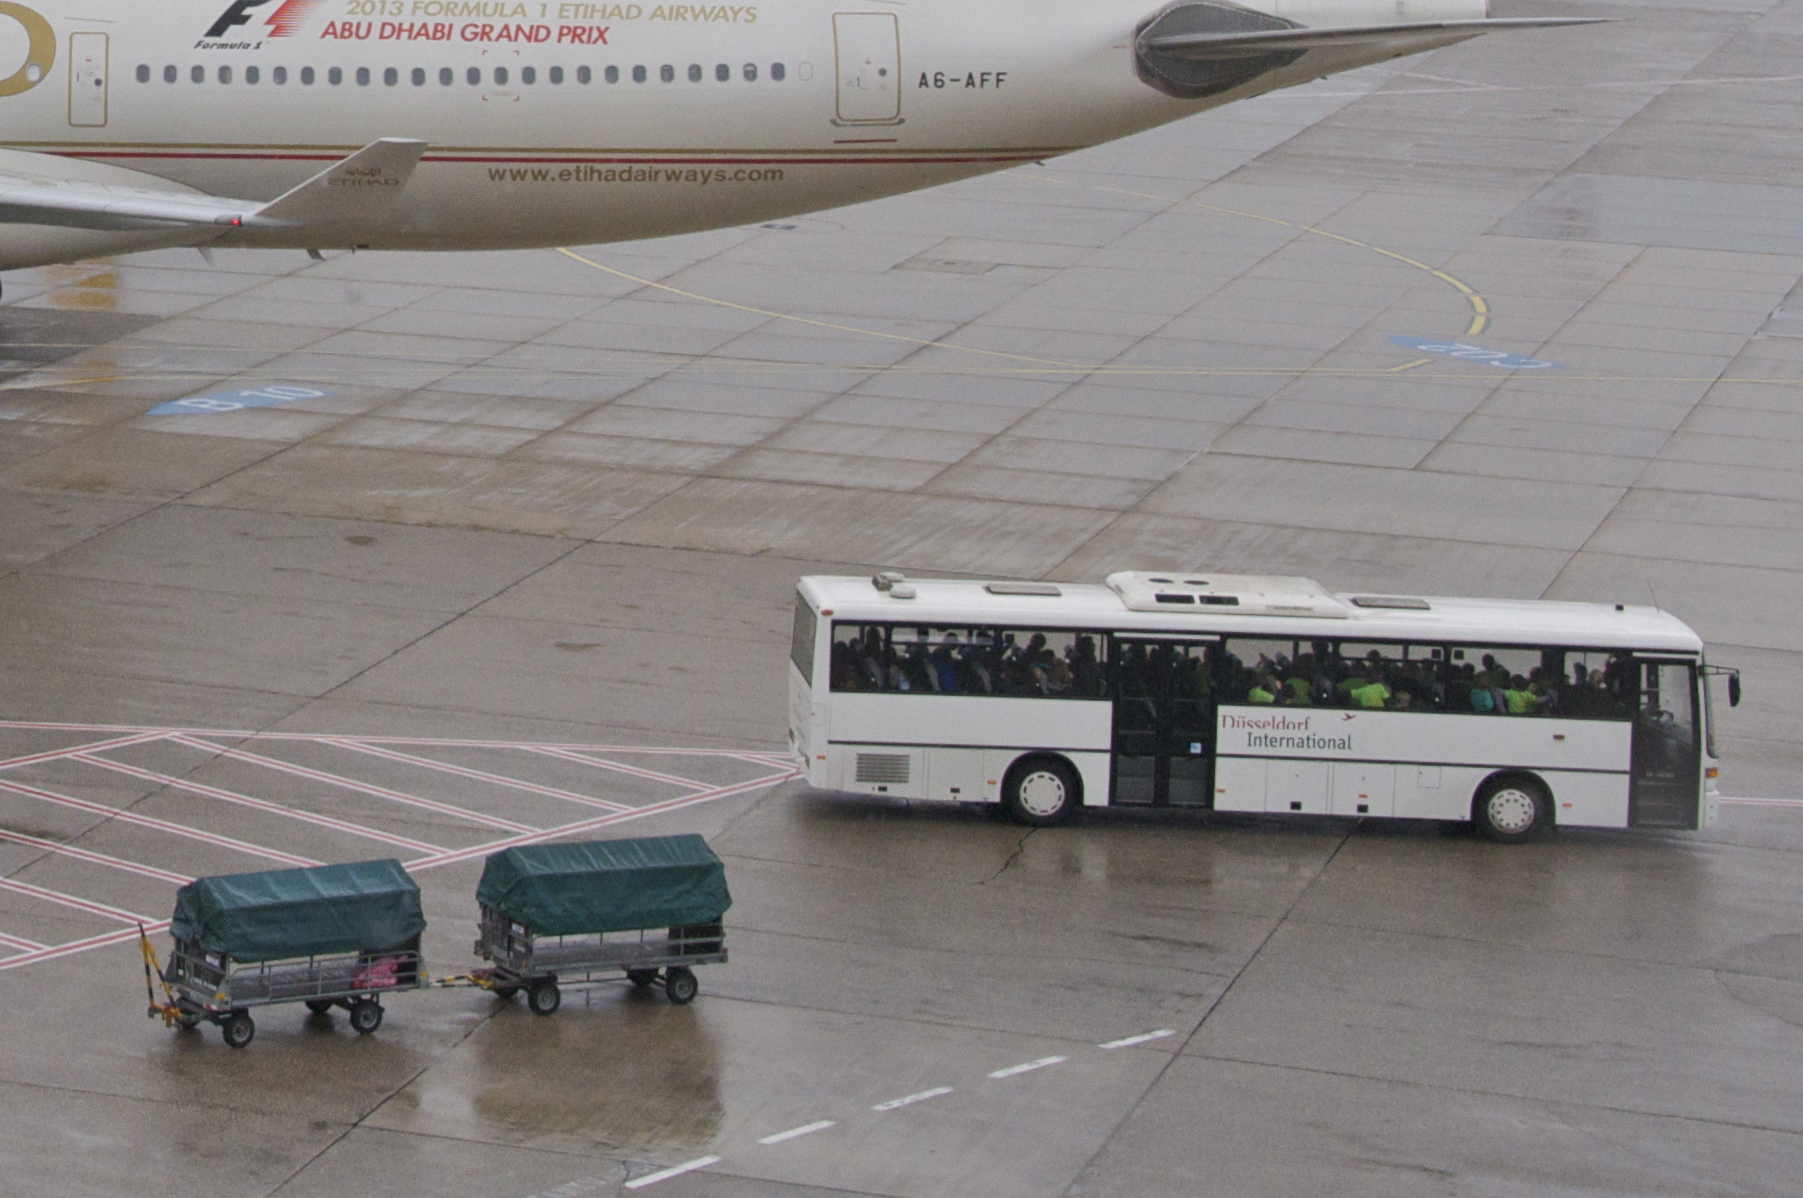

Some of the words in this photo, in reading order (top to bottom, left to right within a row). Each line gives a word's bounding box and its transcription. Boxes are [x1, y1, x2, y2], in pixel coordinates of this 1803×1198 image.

[345, 0, 403, 17] 2013
[410, 1, 527, 18] FORMULA
[539, 3, 547, 19] 1
[557, 3, 643, 21] ETIHAD
[648, 5, 758, 23] AIRWAYS
[320, 21, 372, 40] ABU
[378, 22, 453, 42] DHABI
[459, 22, 551, 43] GRAND
[556, 25, 611, 45] PRIX
[194, 40, 251, 50] Formula
[253, 41, 264, 50] 1
[918, 71, 1008, 89] A6-AFF
[327, 177, 399, 186] ETIHAD
[488, 165, 784, 186] www.etihadairways.com
[1247, 732, 1352, 750] International
